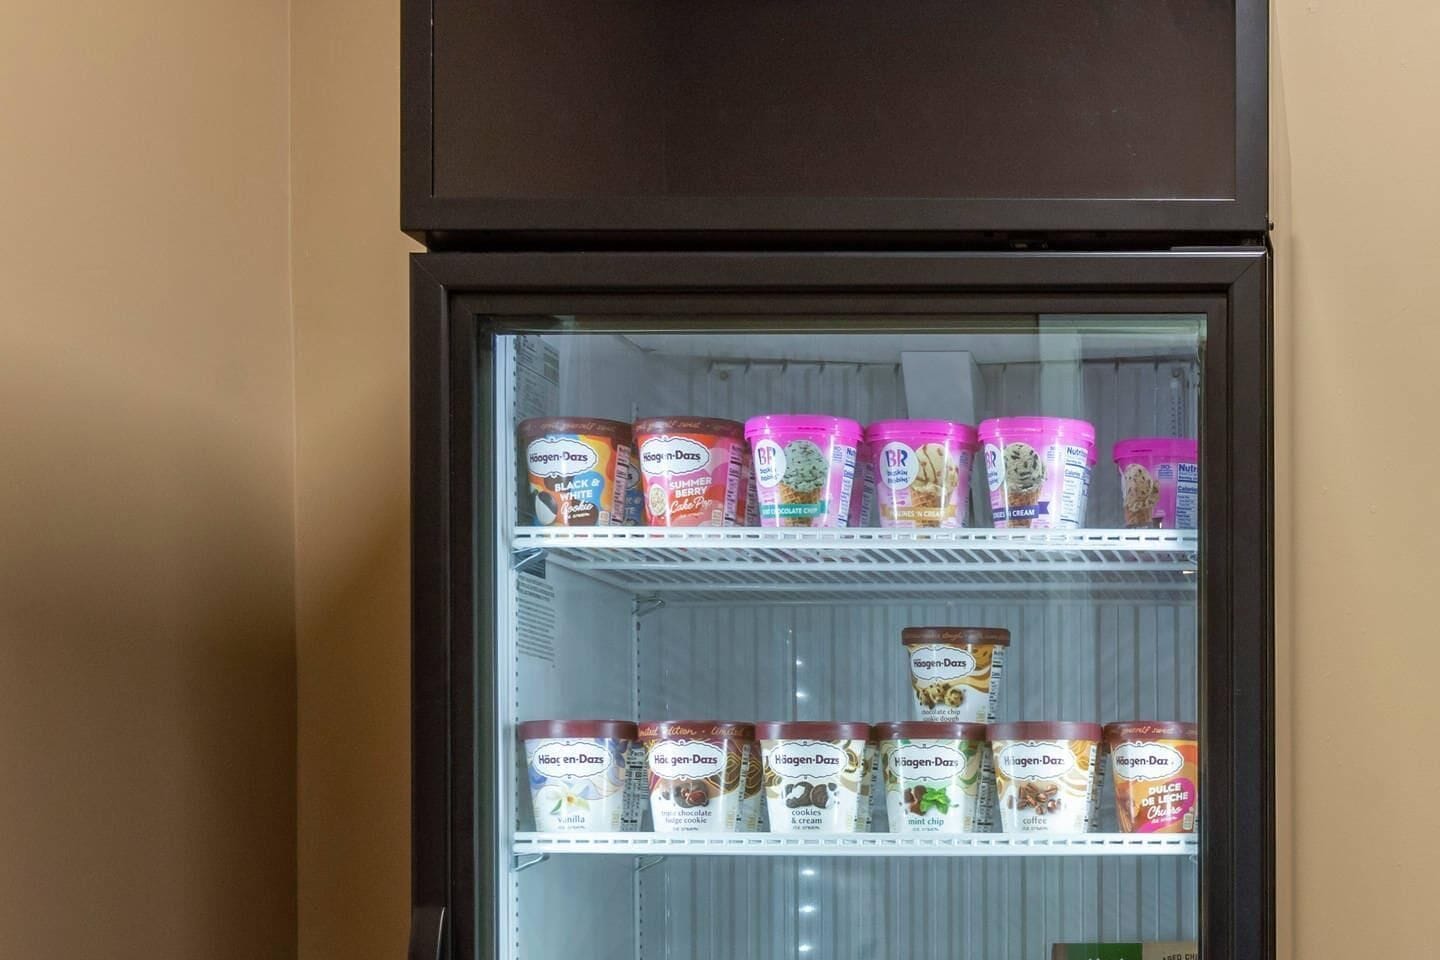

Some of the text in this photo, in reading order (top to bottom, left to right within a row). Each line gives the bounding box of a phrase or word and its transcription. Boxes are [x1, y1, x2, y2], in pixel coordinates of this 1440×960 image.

[885, 448, 908, 467] BR
[554, 479, 590, 492] BLACK
[669, 476, 712, 489] SUMMER
[559, 489, 593, 500] WHITE
[675, 485, 707, 498] BERRY
[561, 500, 593, 516] Cookie
[670, 495, 713, 514] Cake Pop
[1012, 508, 1036, 518] CREAM
[775, 754, 840, 766] Häagen-Dazs
[895, 755, 959, 769] Häagen-Dazs
[1148, 782, 1181, 794] DULCE
[1142, 791, 1189, 808] DE LECHE
[791, 808, 822, 816] cookies
[684, 816, 708, 824] cookie
[908, 817, 945, 828] mint chip
[1023, 816, 1047, 825] coffee
